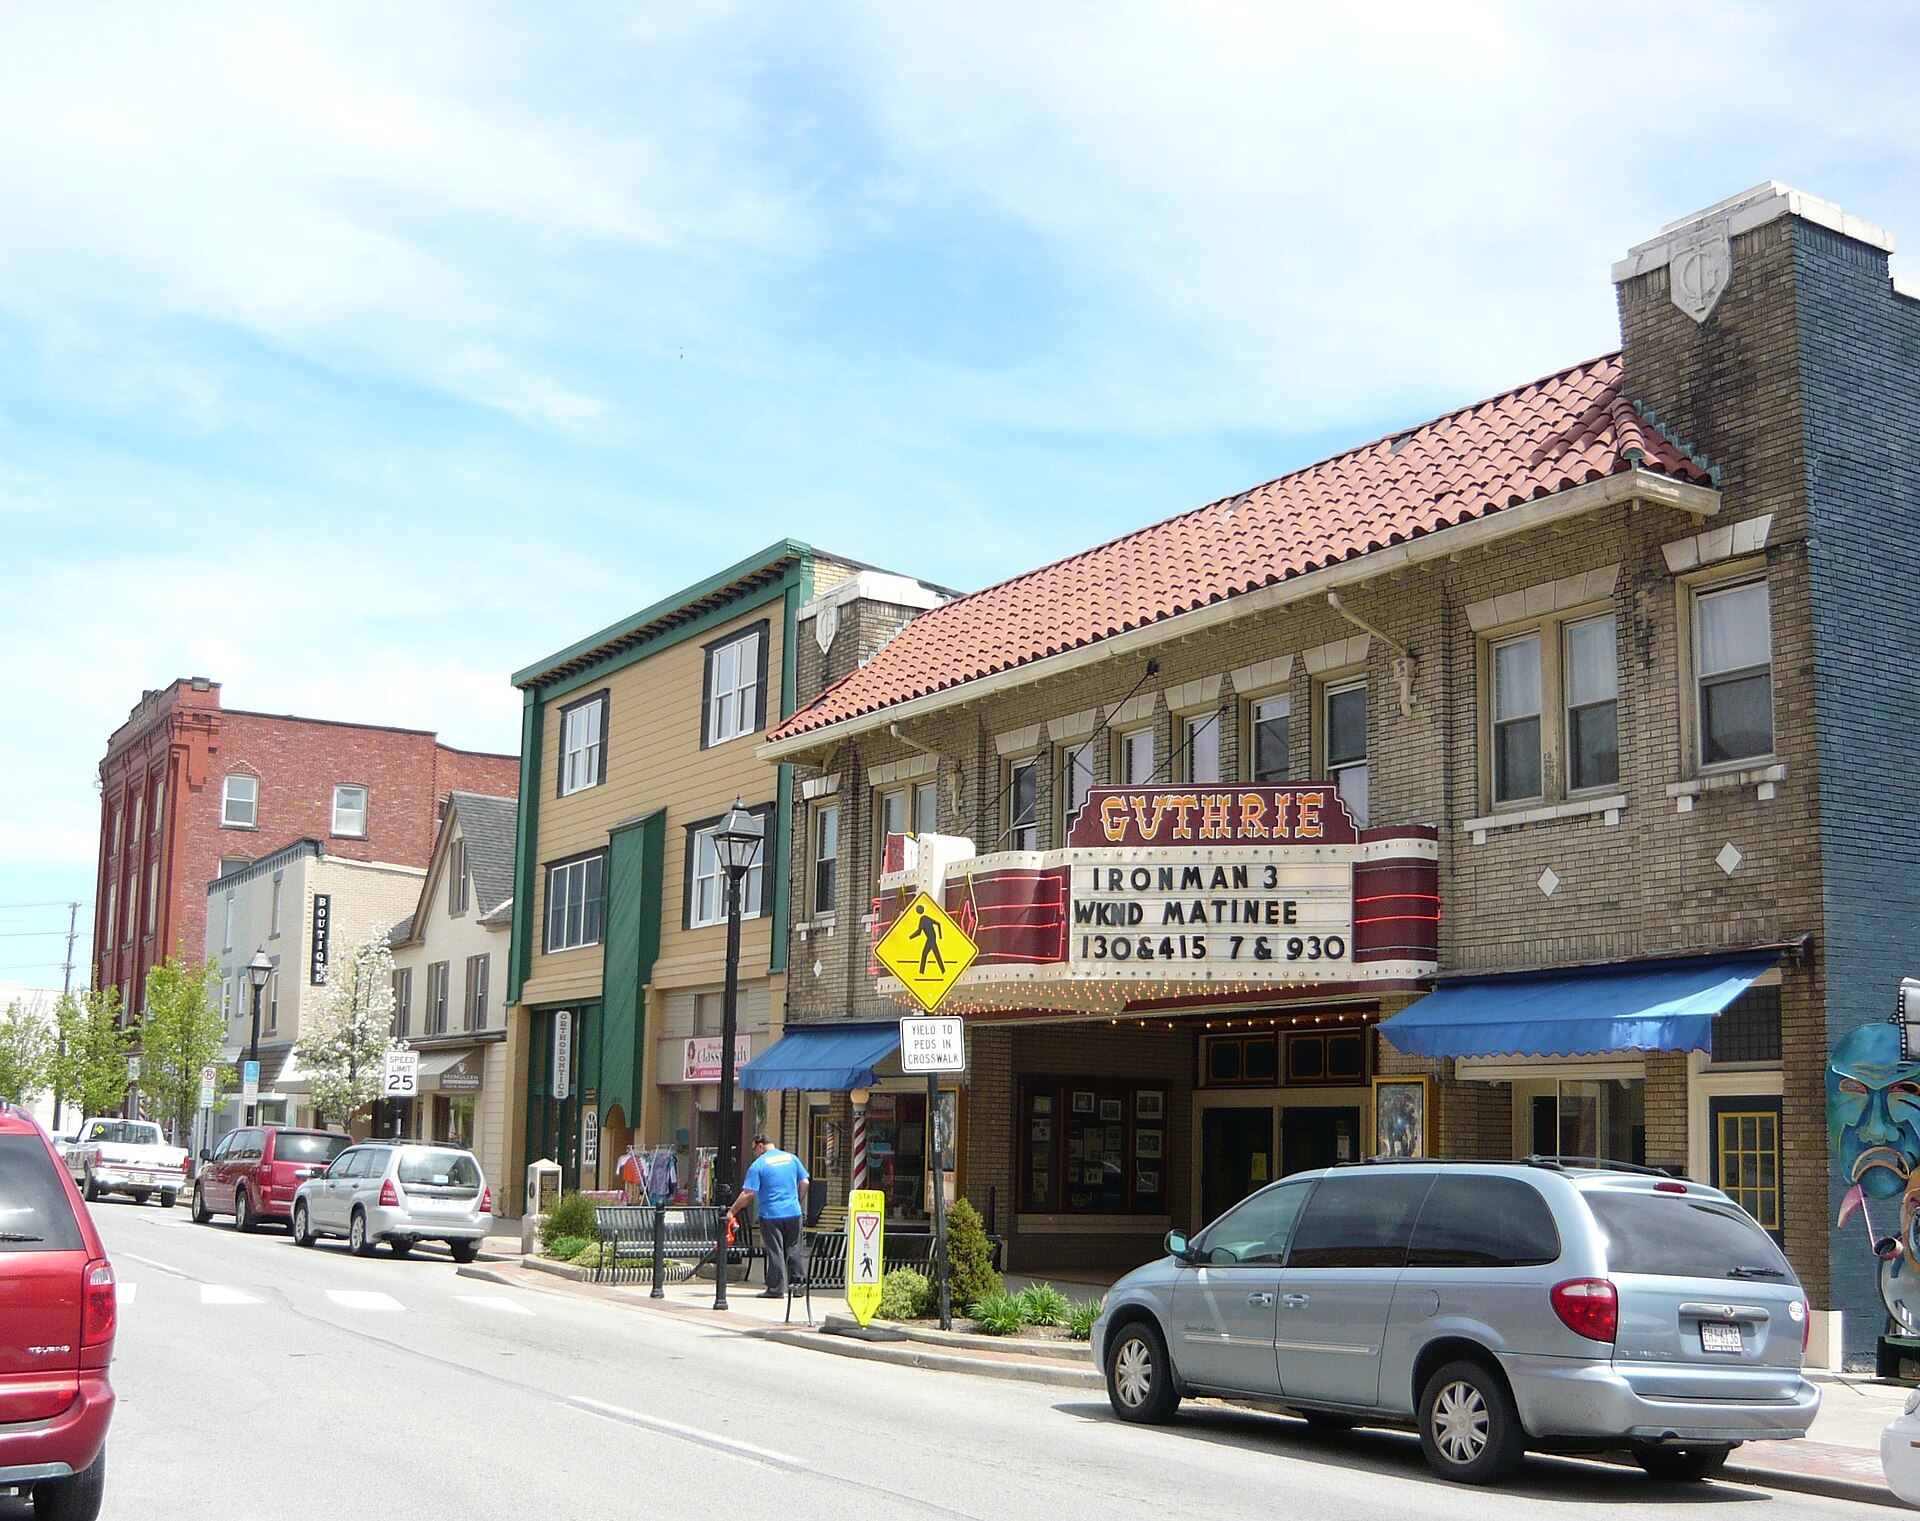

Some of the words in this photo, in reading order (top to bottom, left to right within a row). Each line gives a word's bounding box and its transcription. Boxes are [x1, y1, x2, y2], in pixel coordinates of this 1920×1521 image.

[1100, 792, 1324, 841] GUTHRIE
[1092, 865, 1249, 891] IRONMAN
[1263, 865, 1278, 889] 3
[1074, 900, 1144, 926] WKND
[1161, 900, 1297, 925] MATINEE
[315, 897, 327, 983] BOUTIQUE
[1081, 935, 1207, 960] 130&415
[1229, 935, 1245, 959] 7
[1254, 935, 1273, 960] &
[1286, 935, 1345, 961] 930
[911, 1024, 936, 1036] YIELD
[942, 1024, 953, 1035] TO
[914, 1039, 937, 1050] PEDS
[942, 1038, 952, 1049] IN
[389, 1056, 416, 1064] SPEED
[557, 1013, 568, 1097] ORTHODONTICS
[907, 1053, 959, 1065] CROSSWALK
[391, 1065, 412, 1073] LIMIT
[388, 1074, 414, 1091] 25
